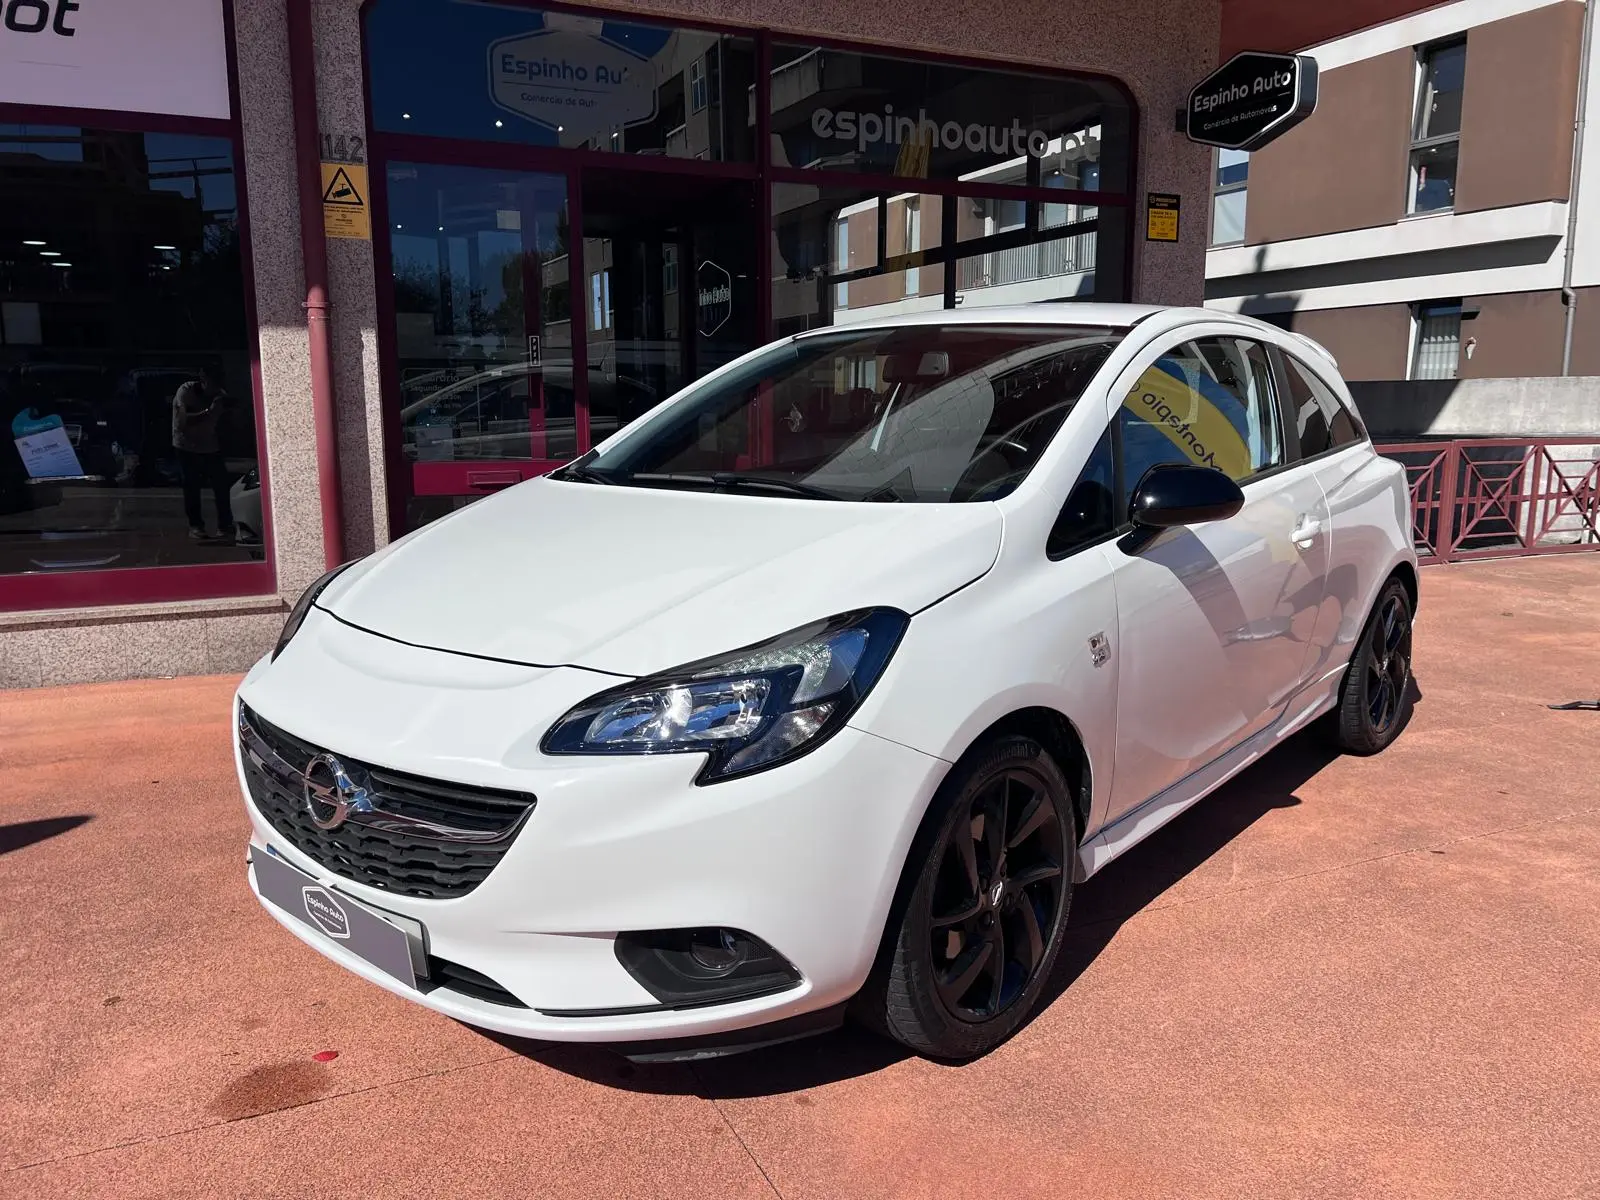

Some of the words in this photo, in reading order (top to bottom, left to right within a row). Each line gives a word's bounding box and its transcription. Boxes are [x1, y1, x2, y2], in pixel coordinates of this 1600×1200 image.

[0, 0, 80, 37] ot
[502, 54, 588, 81] Espinho
[1194, 83, 1249, 112] Espinho
[1253, 70, 1291, 94] Auto
[1231, 114, 1239, 123] de
[811, 103, 1100, 171] espinhoauto.pt
[306, 893, 329, 915] Espinho
[328, 907, 344, 923] Auto
